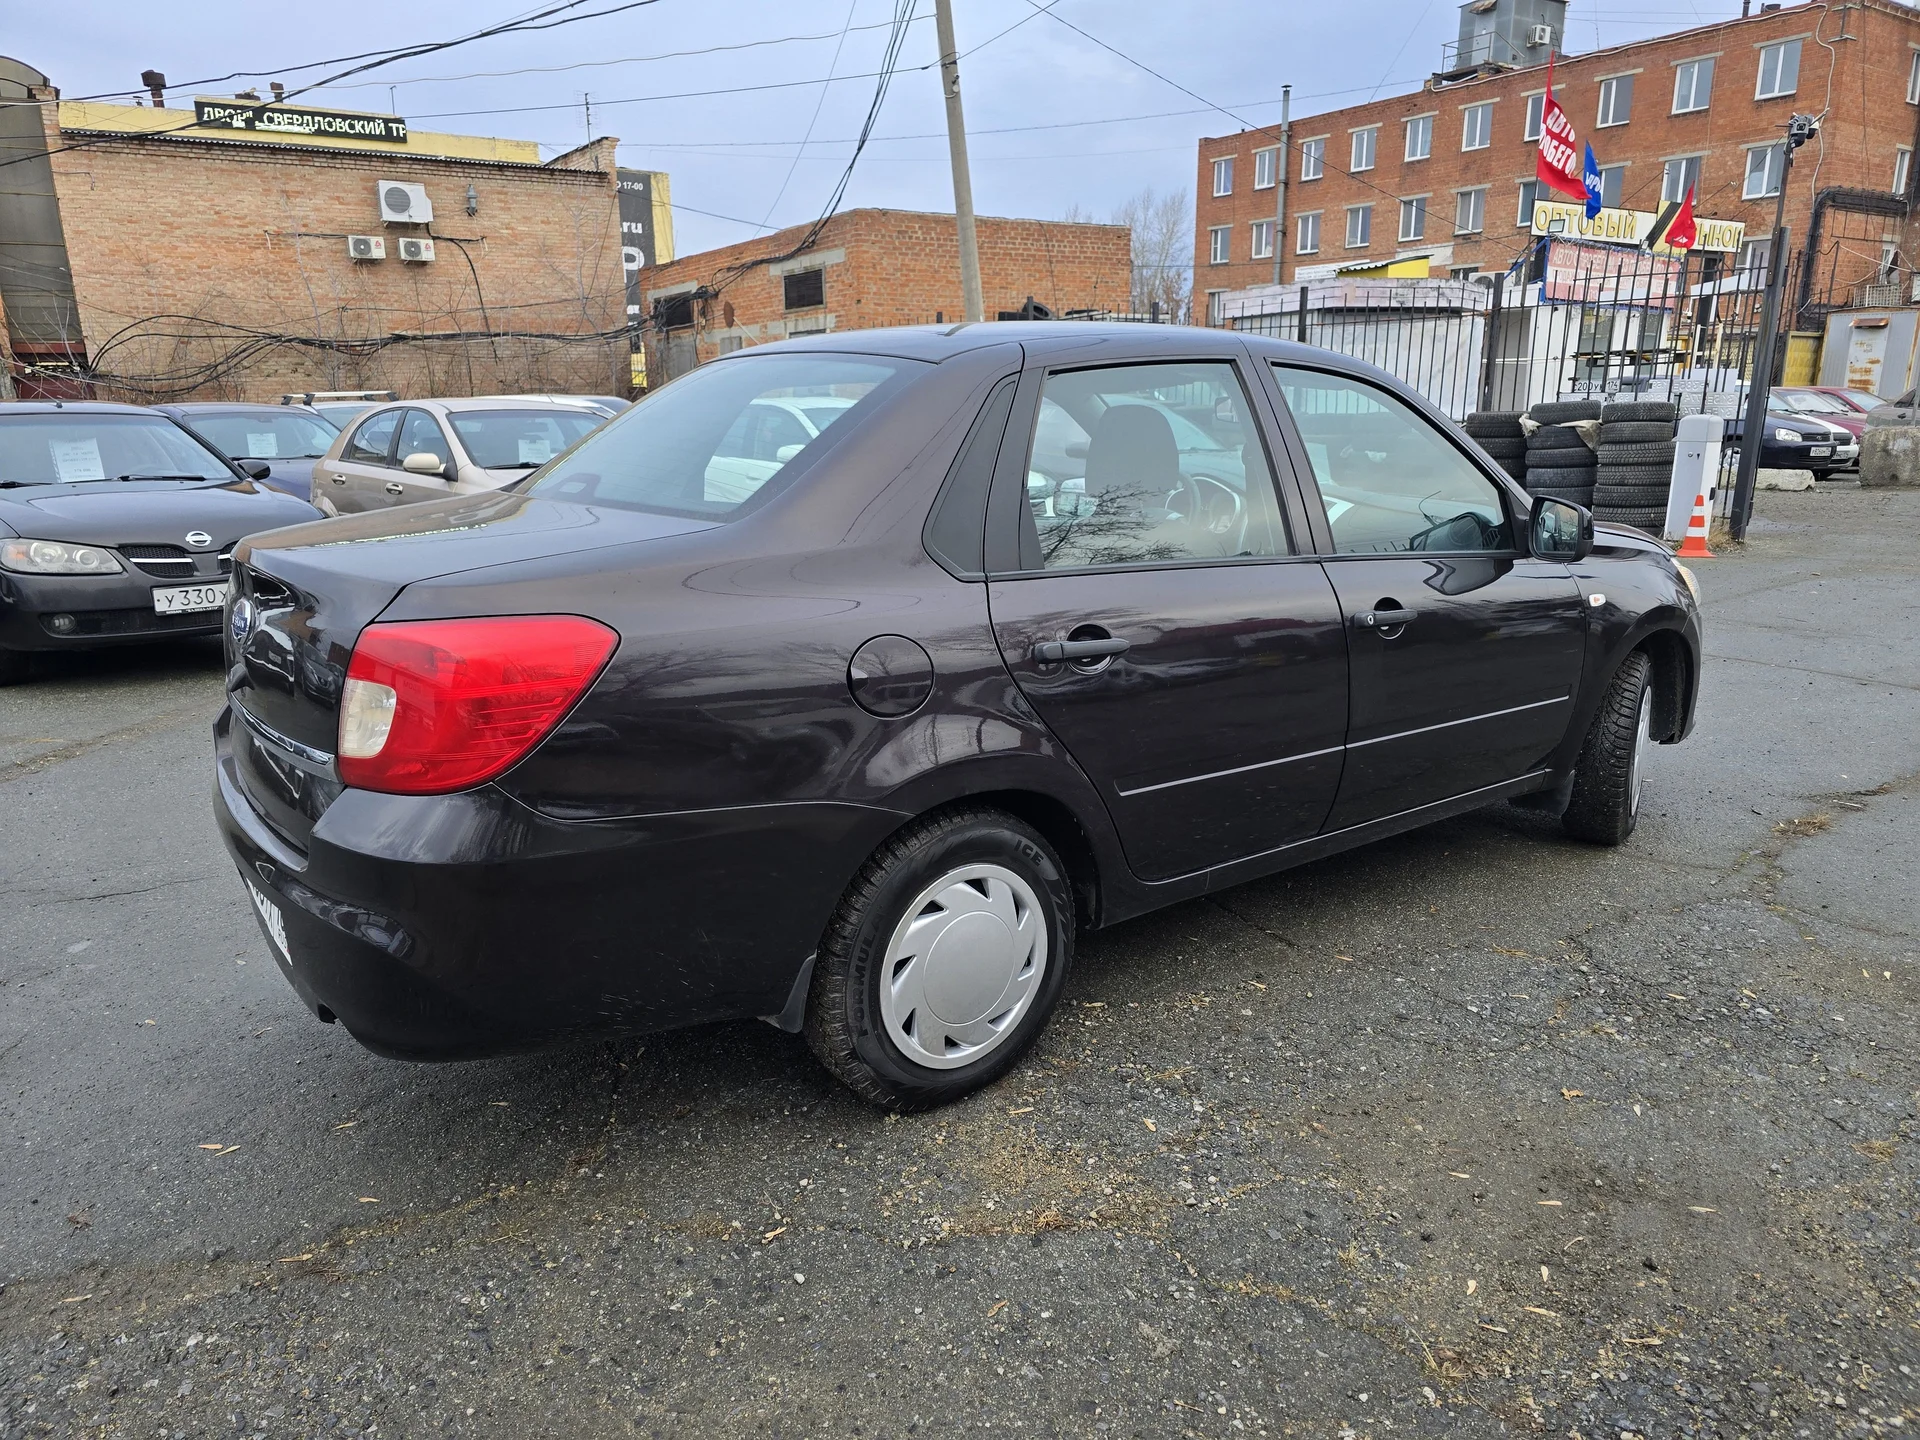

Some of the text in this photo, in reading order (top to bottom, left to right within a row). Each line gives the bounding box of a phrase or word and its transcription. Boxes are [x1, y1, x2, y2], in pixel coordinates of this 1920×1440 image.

[263, 111, 386, 135] СВЕРДЛОВСКИЙ
[623, 181, 644, 191] 17-00
[1014, 839, 1045, 867] ICE
